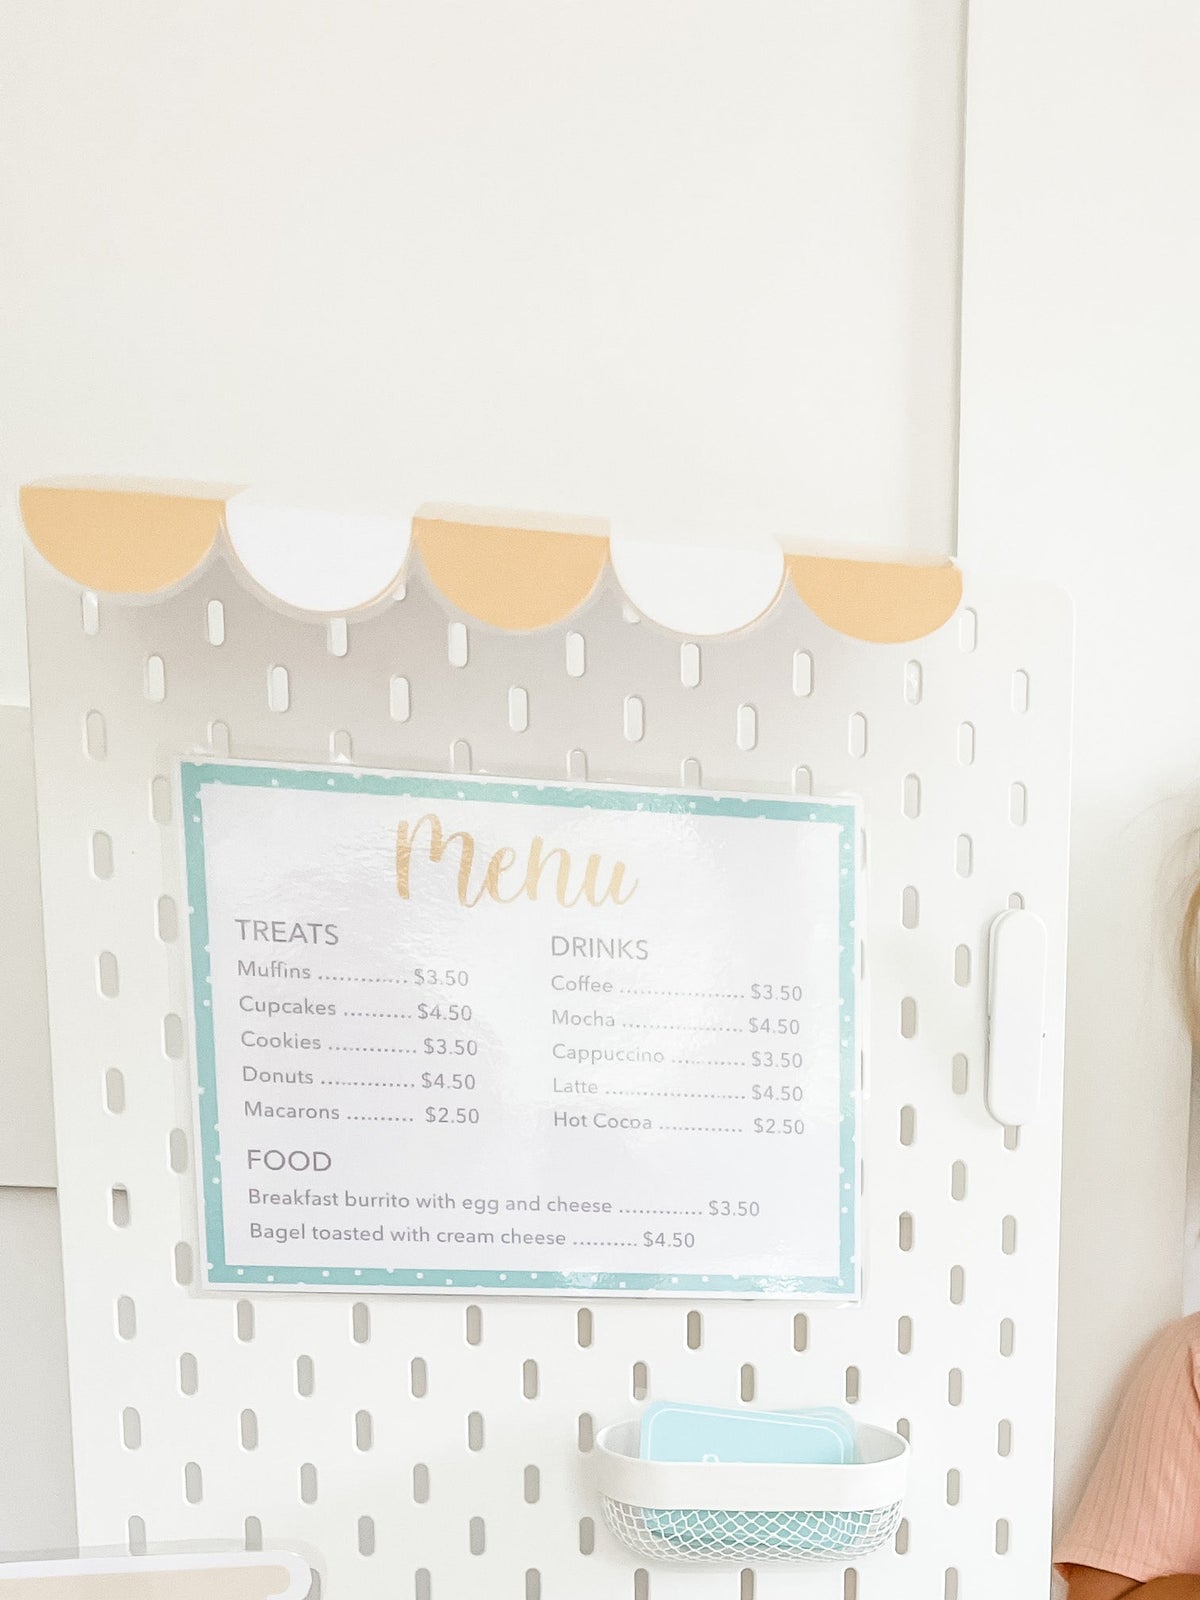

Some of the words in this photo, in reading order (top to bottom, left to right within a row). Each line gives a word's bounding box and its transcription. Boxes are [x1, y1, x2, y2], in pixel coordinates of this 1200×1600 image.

[394, 813, 640, 908] Menu
[234, 918, 339, 946] TREATS
[551, 935, 649, 961] DRINKS
[237, 959, 311, 980] Muffins
[414, 968, 469, 986] $3.50
[551, 975, 613, 993] Coffee
[751, 983, 802, 1001] $3.50
[239, 995, 336, 1017] Cupcakes
[417, 1002, 472, 1021] $4.50
[552, 1009, 615, 1027] Mocha
[749, 1017, 800, 1035] $4.50
[241, 1030, 321, 1050] Cookies
[423, 1037, 478, 1056] $3.50
[552, 1043, 664, 1065] Cappuccino
[751, 1051, 803, 1069] $3.50
[243, 1065, 314, 1084] Donuts
[421, 1072, 476, 1090] $4.50
[553, 1077, 598, 1095] Latte
[751, 1084, 803, 1102] $4.50
[244, 1100, 340, 1120] Macarons
[425, 1106, 480, 1124] $2.50
[554, 1111, 588, 1128] Hot
[593, 1112, 652, 1129] Cocoa
[753, 1117, 805, 1135] $2.50
[247, 1149, 332, 1172] FOOD
[248, 1188, 339, 1207] Breakfast
[345, 1190, 410, 1208] burrito
[415, 1192, 456, 1209] with
[462, 1198, 499, 1214] egg
[505, 1195, 541, 1211] and
[546, 1196, 613, 1213] cheese
[708, 1200, 760, 1217] $3.50
[250, 1222, 305, 1243] Bagel
[312, 1225, 384, 1241] toasted
[390, 1226, 430, 1242] with
[436, 1230, 495, 1244] cream
[501, 1228, 566, 1245] cheese
[643, 1231, 695, 1249] $4.50
